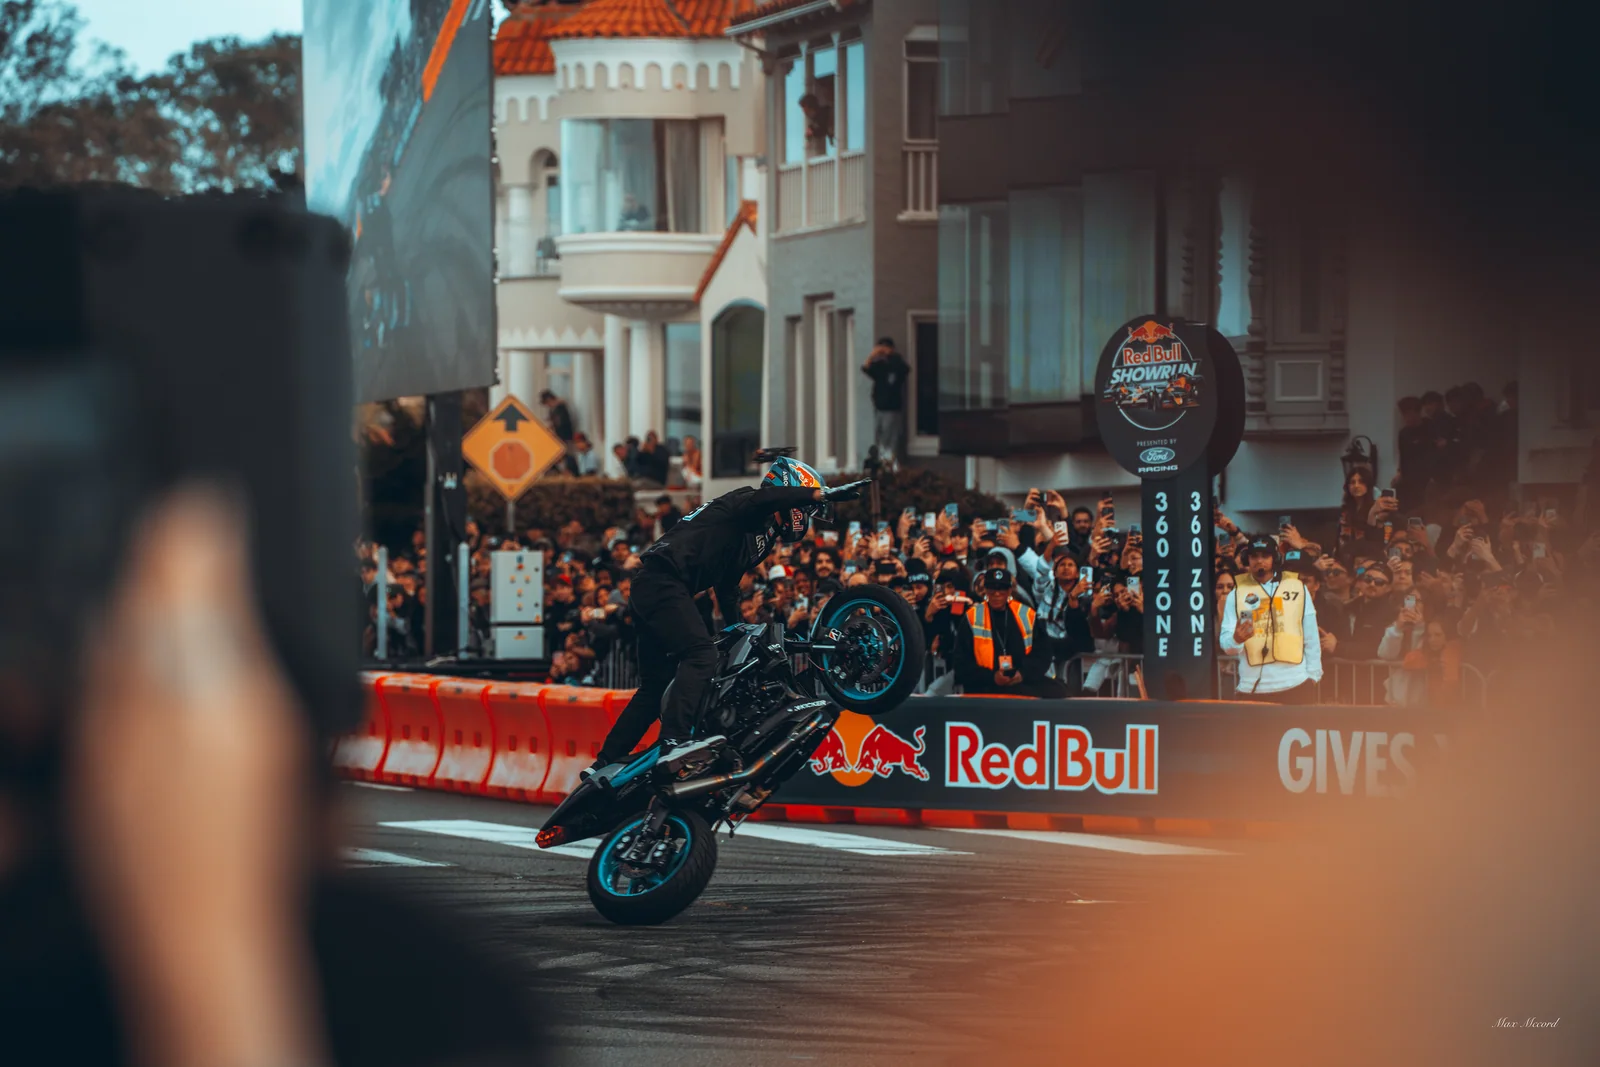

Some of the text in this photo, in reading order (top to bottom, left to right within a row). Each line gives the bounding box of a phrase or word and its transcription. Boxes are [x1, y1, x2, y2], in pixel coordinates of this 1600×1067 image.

[1122, 343, 1182, 365] Red Bull
[1110, 362, 1197, 384] SHOWRUN
[1146, 450, 1169, 462] Ford
[1138, 465, 1178, 473] RACING
[1155, 492, 1171, 656] 360 ZONE
[1189, 491, 1204, 656] 360 ZONE
[1282, 591, 1300, 601] 37
[945, 721, 1417, 797] Red Bull GIVES
